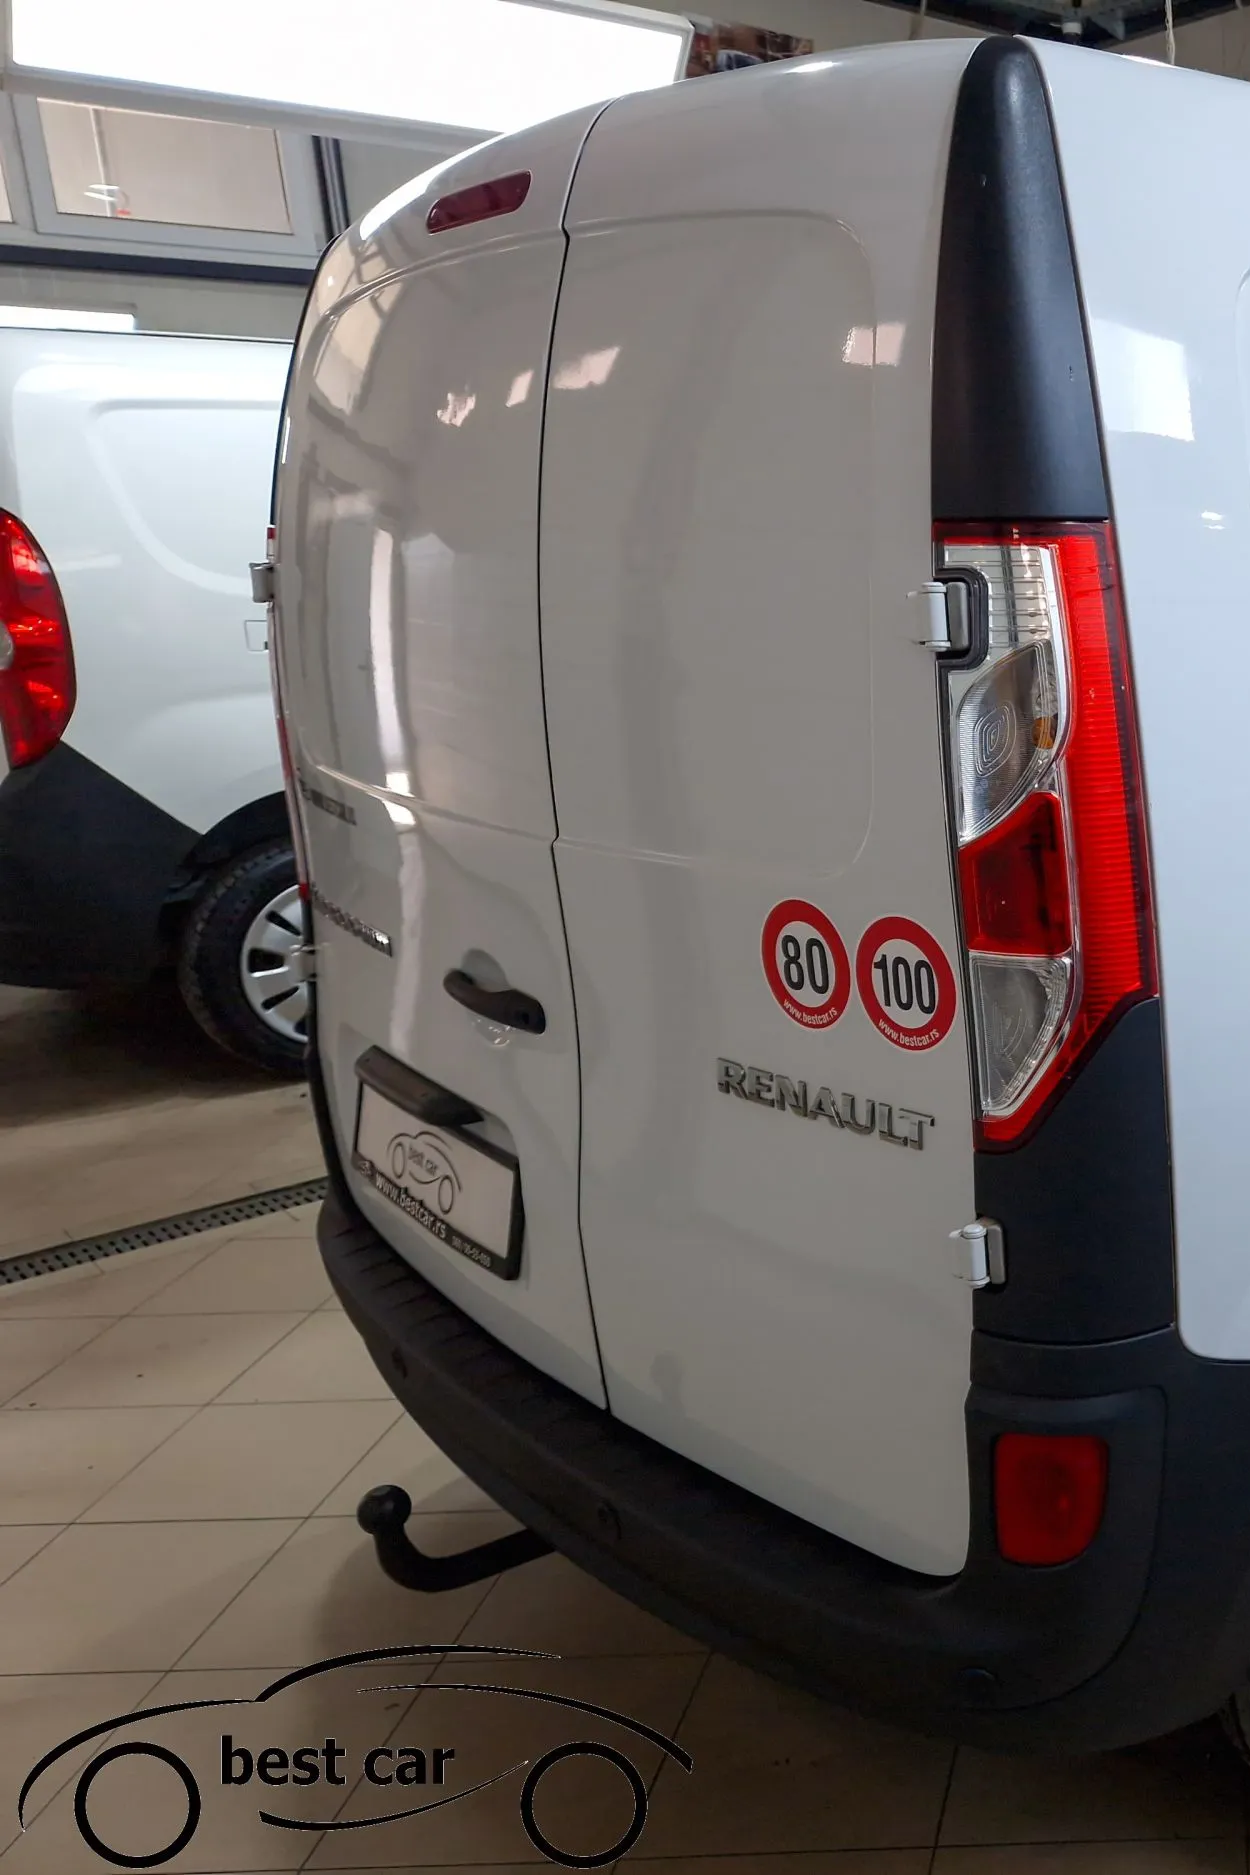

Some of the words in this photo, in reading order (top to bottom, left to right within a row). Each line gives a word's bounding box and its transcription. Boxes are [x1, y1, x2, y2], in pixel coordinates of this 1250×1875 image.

[782, 935, 830, 994] 80
[873, 953, 936, 1015] 100
[783, 998, 838, 1026] www.bestcar.rs
[878, 1018, 940, 1047] www.bestcar.rs
[717, 1057, 935, 1150] RENAULT
